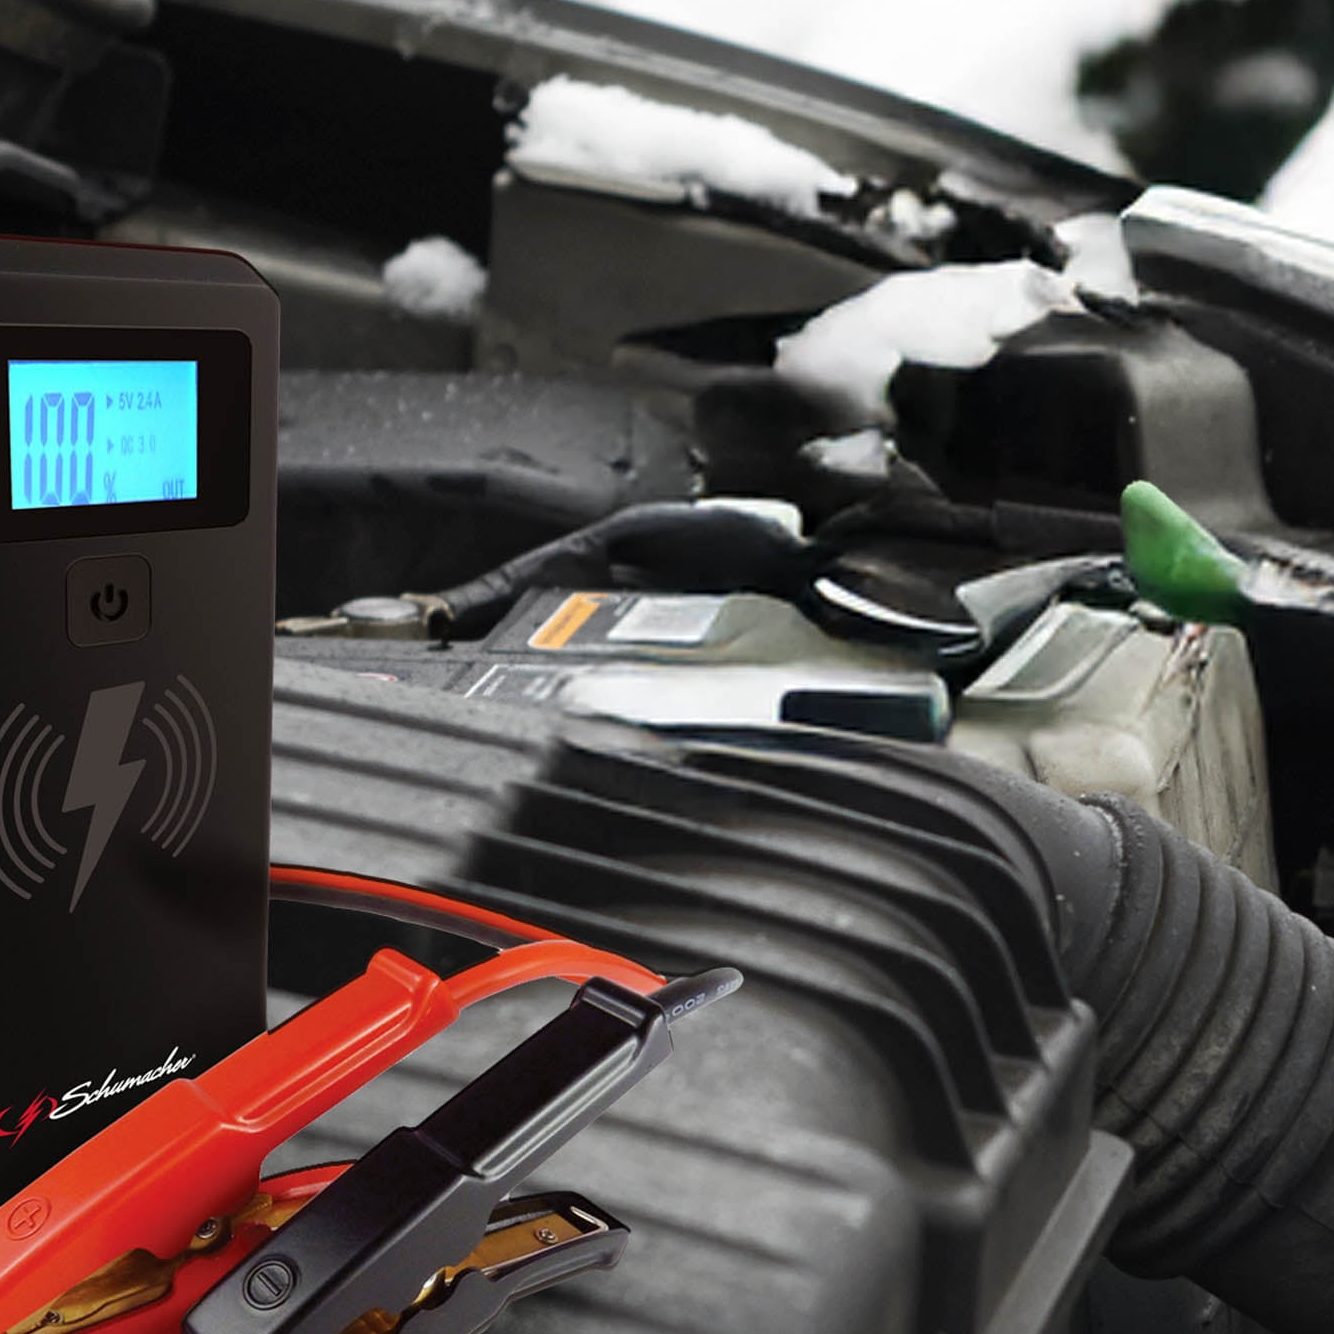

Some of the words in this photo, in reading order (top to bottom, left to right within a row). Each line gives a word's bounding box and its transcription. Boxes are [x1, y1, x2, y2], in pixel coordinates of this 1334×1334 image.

[118, 391, 134, 411] 5V
[162, 478, 186, 500] OUT
[50, 1046, 193, 1119] Schumacher
